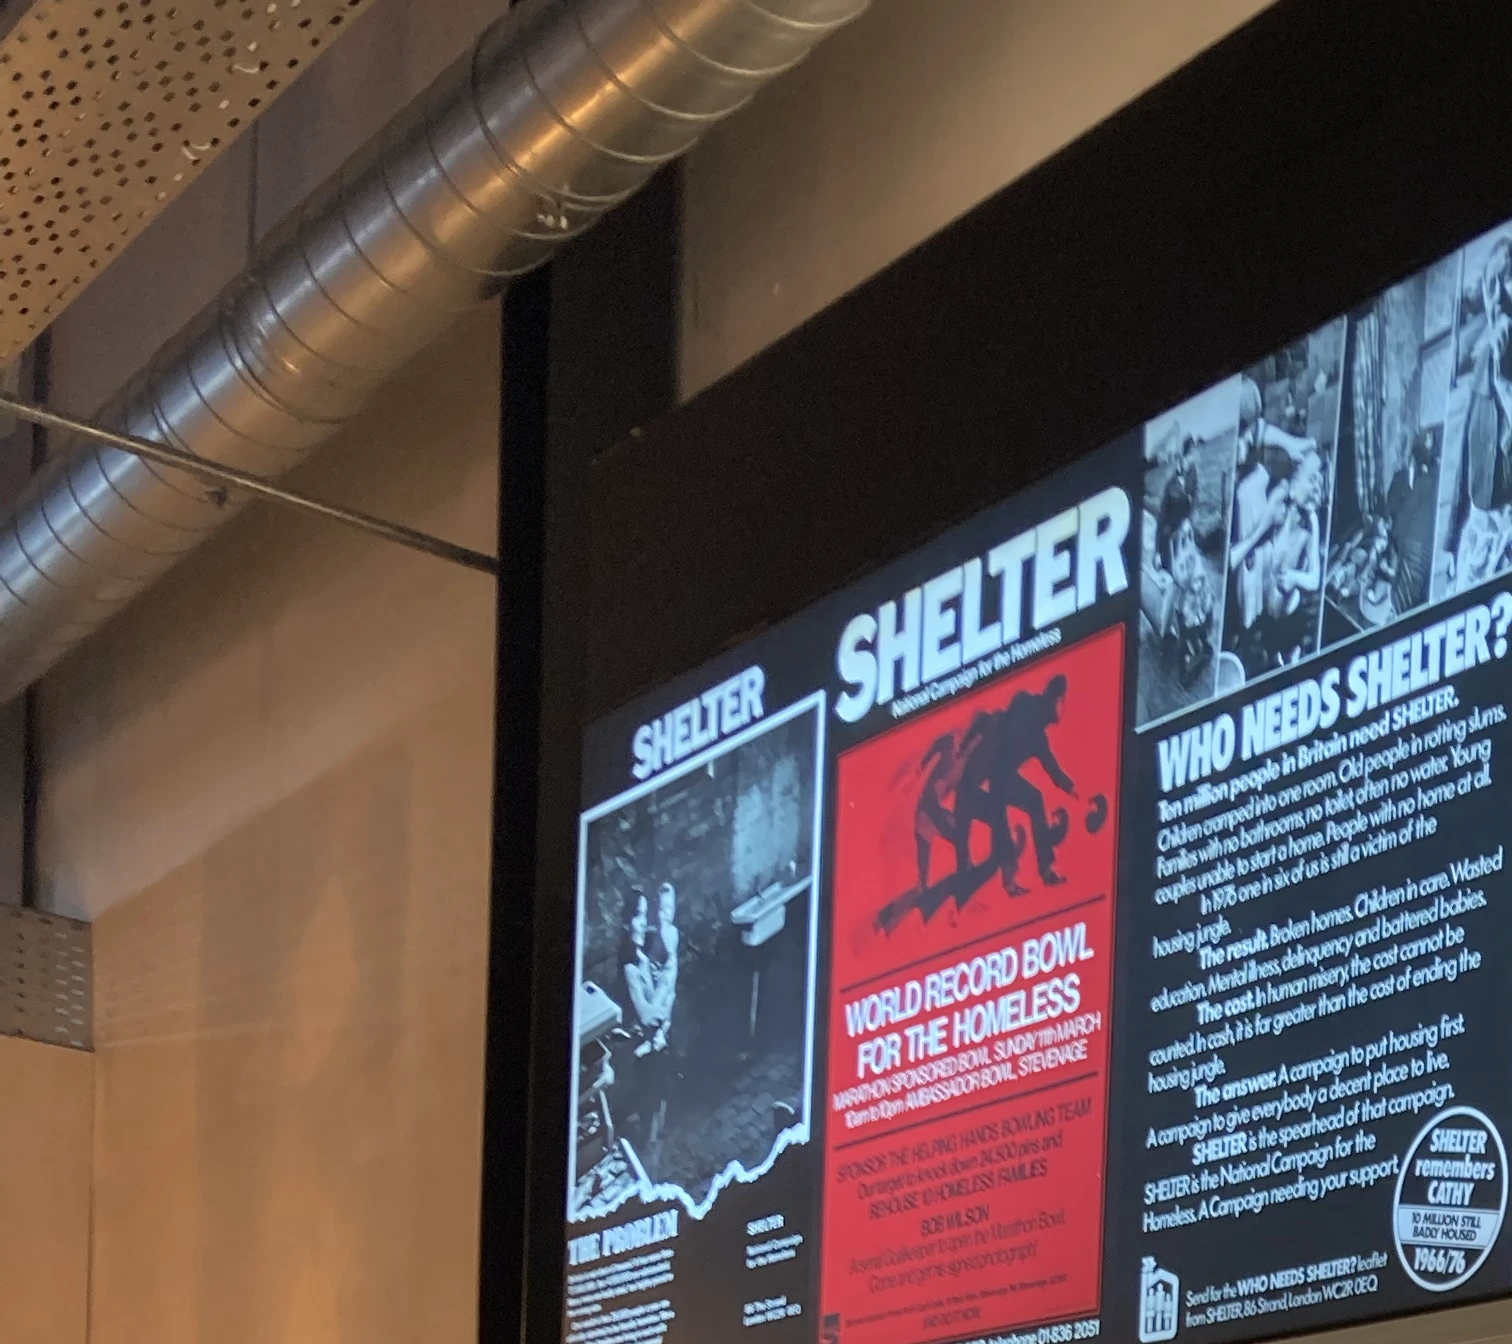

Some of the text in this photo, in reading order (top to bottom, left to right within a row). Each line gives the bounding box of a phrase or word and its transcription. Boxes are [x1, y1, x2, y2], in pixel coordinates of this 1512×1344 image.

[834, 486, 1131, 723] SHELTER
[631, 665, 765, 780] SHELTER
[1158, 714, 1234, 792] WHO
[1241, 668, 1340, 761] NEEDS
[1158, 684, 1458, 825] Ten million people in Britain need SHELTER.
[846, 922, 1094, 1037] WORLD RECORD BOWL
[858, 973, 1081, 1079] FOR THE HOMELESS
[1192, 1130, 1247, 1166] SHELTER
[1248, 1129, 1256, 1151] is
[1259, 1124, 1276, 1148] the
[1279, 1104, 1343, 1145] spearhead
[1345, 1100, 1360, 1125] of
[1361, 1094, 1385, 1121] that
[1430, 1129, 1487, 1154] SHELTER
[1143, 1173, 1190, 1206] SHELTER
[1201, 1167, 1218, 1192] the
[1220, 1153, 1270, 1187] National
[1271, 1141, 1332, 1174] Campaign
[1334, 1136, 1352, 1159] for
[1355, 1129, 1375, 1154] the
[1415, 1154, 1495, 1181] remembers
[1199, 1198, 1209, 1220] A
[1210, 1187, 1268, 1217] Campaign
[1270, 1175, 1318, 1203] needing
[1319, 1171, 1347, 1197] your
[1427, 1181, 1474, 1205] CATHY
[1412, 1212, 1481, 1229] 10 MILLION STILL
[1413, 1226, 1477, 1241] BADLY HOUSED
[1237, 1274, 1267, 1296] WHO
[1270, 1267, 1304, 1289] NEEDS
[1306, 1256, 1356, 1282] SHELTER?
[1414, 1247, 1466, 1274] 1966/76
[1186, 1311, 1205, 1328] from
[1289, 1287, 1321, 1308] London
